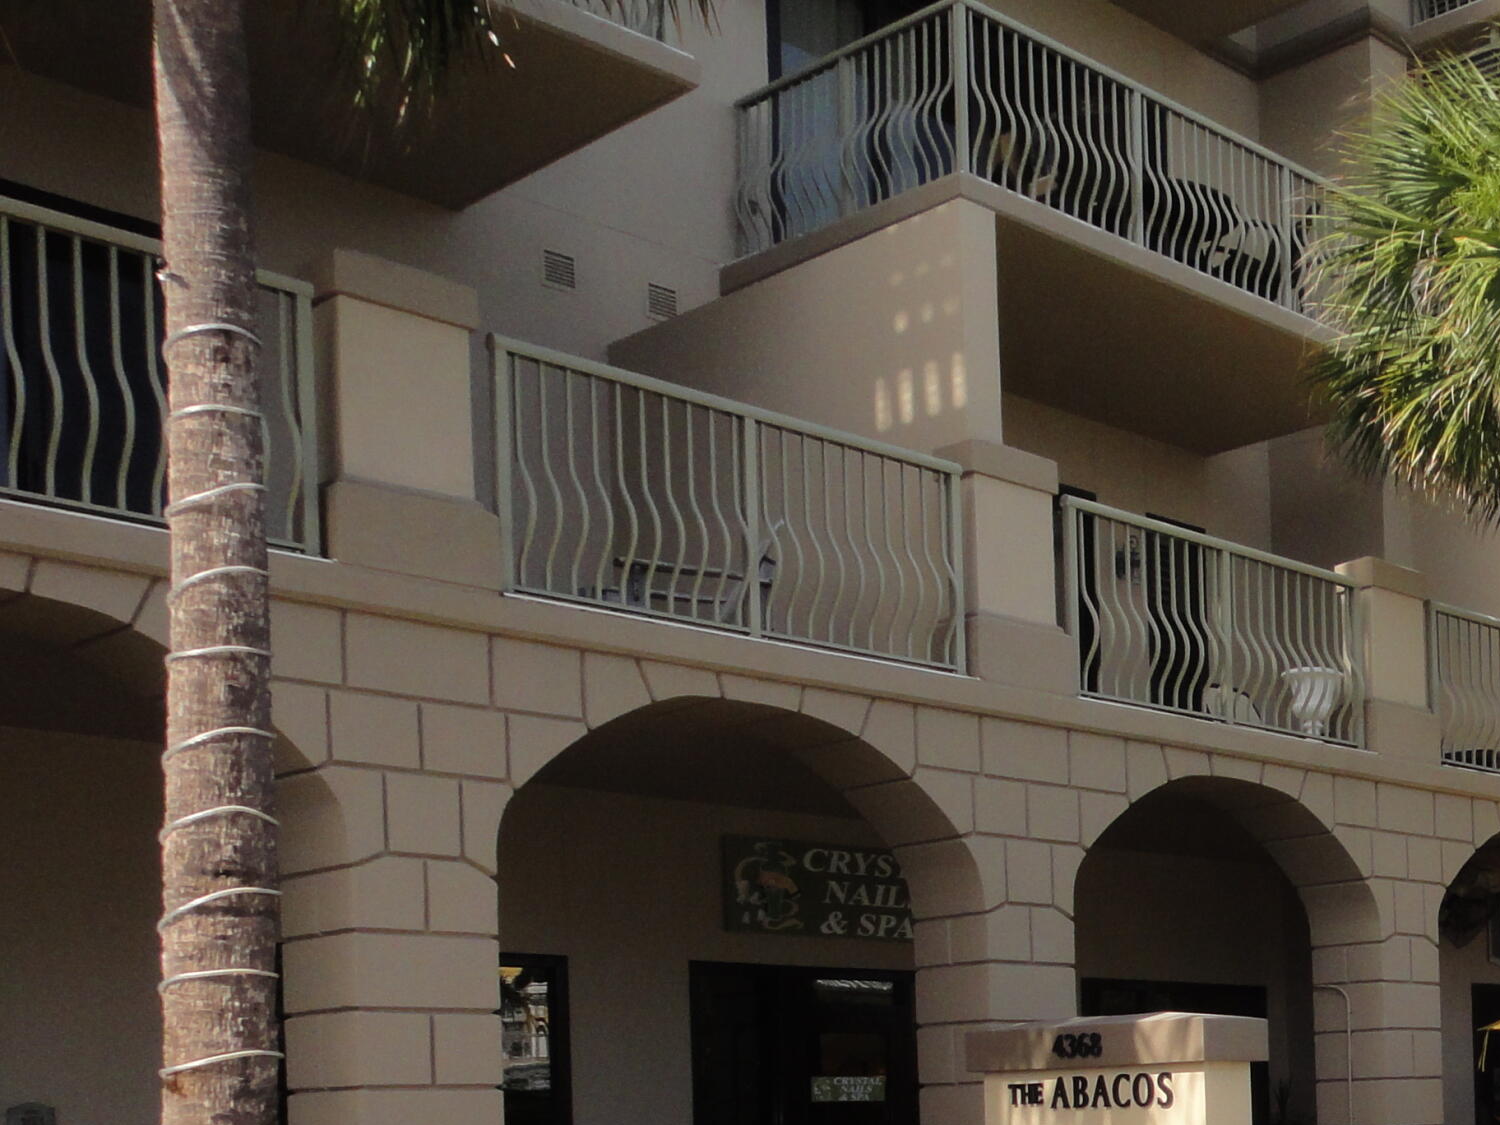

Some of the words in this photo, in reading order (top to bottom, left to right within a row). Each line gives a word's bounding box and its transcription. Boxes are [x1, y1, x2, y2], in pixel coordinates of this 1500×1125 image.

[803, 848, 902, 880] CRYS
[825, 881, 912, 908] NAIL
[820, 911, 848, 936] &
[857, 914, 914, 939] SPA
[1052, 1032, 1103, 1058] 4368
[1008, 1082, 1044, 1106] THE
[1050, 1072, 1175, 1109] ABACOS
